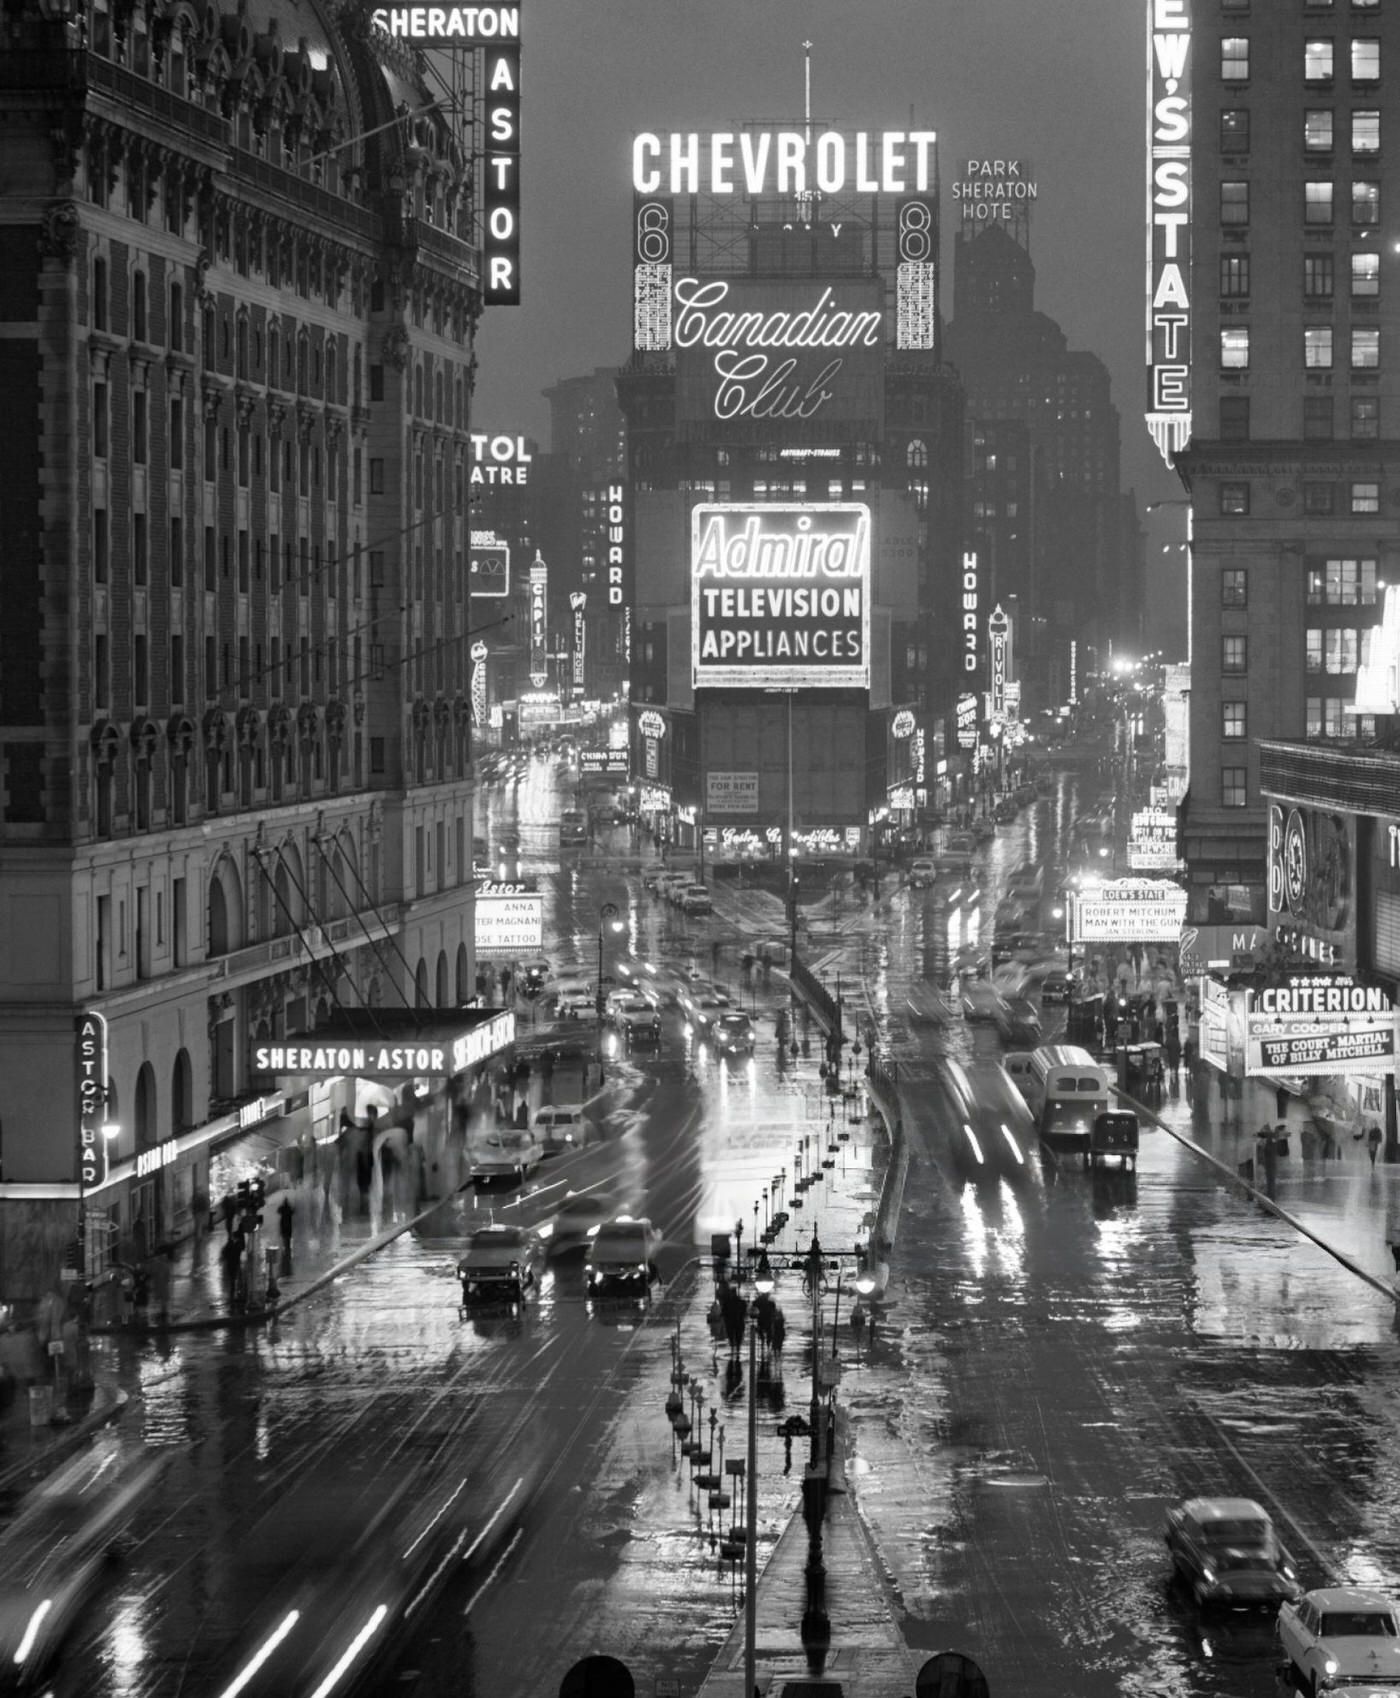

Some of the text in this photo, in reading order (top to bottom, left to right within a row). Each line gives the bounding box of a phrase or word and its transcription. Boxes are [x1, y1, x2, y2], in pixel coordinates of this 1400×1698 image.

[373, 8, 518, 37] SHERATON
[490, 58, 513, 289] ASTOR
[633, 130, 935, 193] CHEVROLET
[967, 160, 1019, 175] PARK
[952, 182, 1037, 198] SHERATON
[1154, 162, 1189, 410] STATE
[674, 278, 882, 347] Canadian
[714, 350, 843, 419] Club
[471, 434, 531, 462] TOL
[471, 466, 527, 484] ATRE
[609, 486, 623, 604] HOWARD
[696, 514, 867, 578] Admiral
[704, 588, 859, 617] TELEVISION
[963, 552, 977, 671] HOWARD
[575, 611, 583, 683] HELLINGER
[701, 630, 859, 658] APPLIANCES
[994, 636, 1003, 710] RIVOLI
[711, 782, 756, 790] FOR RENT
[504, 903, 534, 911] ANNA
[1138, 890, 1164, 900] STATE
[1085, 908, 1176, 917] ROBERT MITCHUM
[1086, 919, 1180, 927] MAN WITH THE GUN
[498, 935, 536, 944] TATTOO
[1263, 987, 1382, 1012] CRITERION
[1253, 1023, 1348, 1034] GARY COOPER
[1265, 1042, 1288, 1055] THE
[1271, 1045, 1385, 1065] OF BILLY MITCHELL
[81, 1021, 97, 1182] ASTOR BAR
